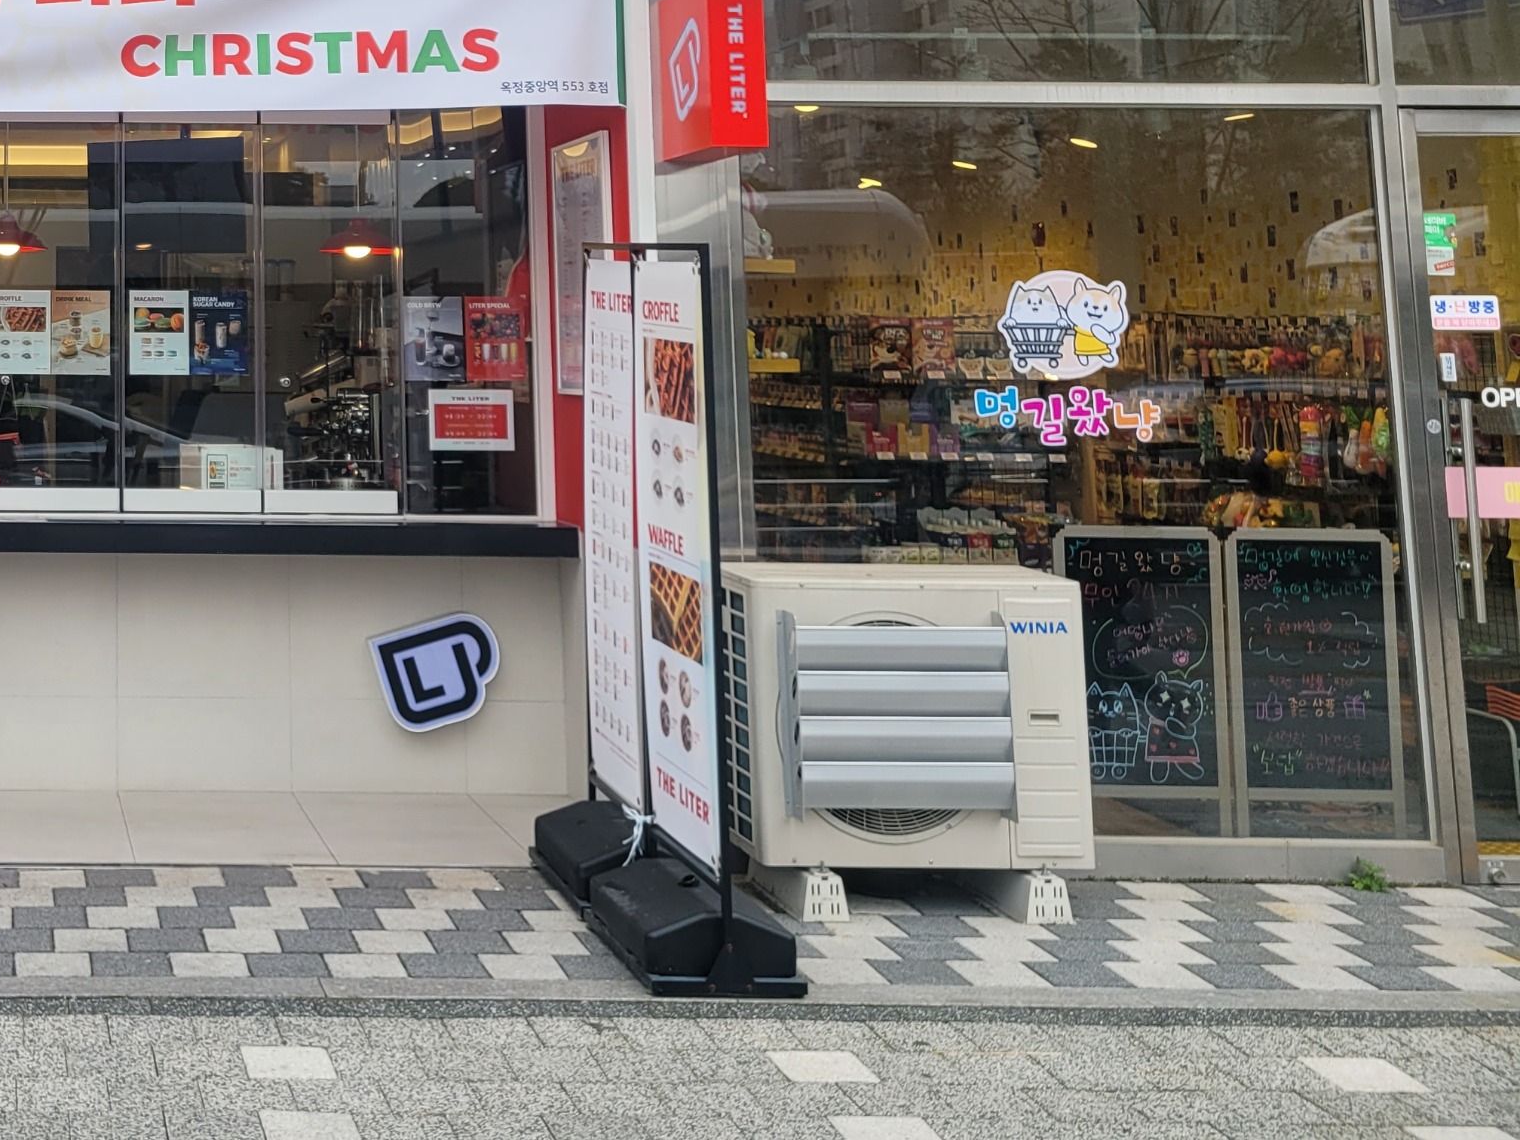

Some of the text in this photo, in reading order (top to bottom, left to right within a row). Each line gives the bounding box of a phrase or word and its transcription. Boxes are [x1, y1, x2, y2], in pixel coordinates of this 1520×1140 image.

[120, 29, 500, 77] CHRISTMAS
[727, 3, 747, 115] THE LITER
[500, 80, 609, 95] 옥정중앙역 553 호점
[591, 290, 632, 315] THE LITER
[642, 300, 679, 323] CROFFLE
[648, 523, 684, 556] WAFFLE
[1010, 621, 1068, 634] WINIA
[656, 765, 709, 825] THE LITER
